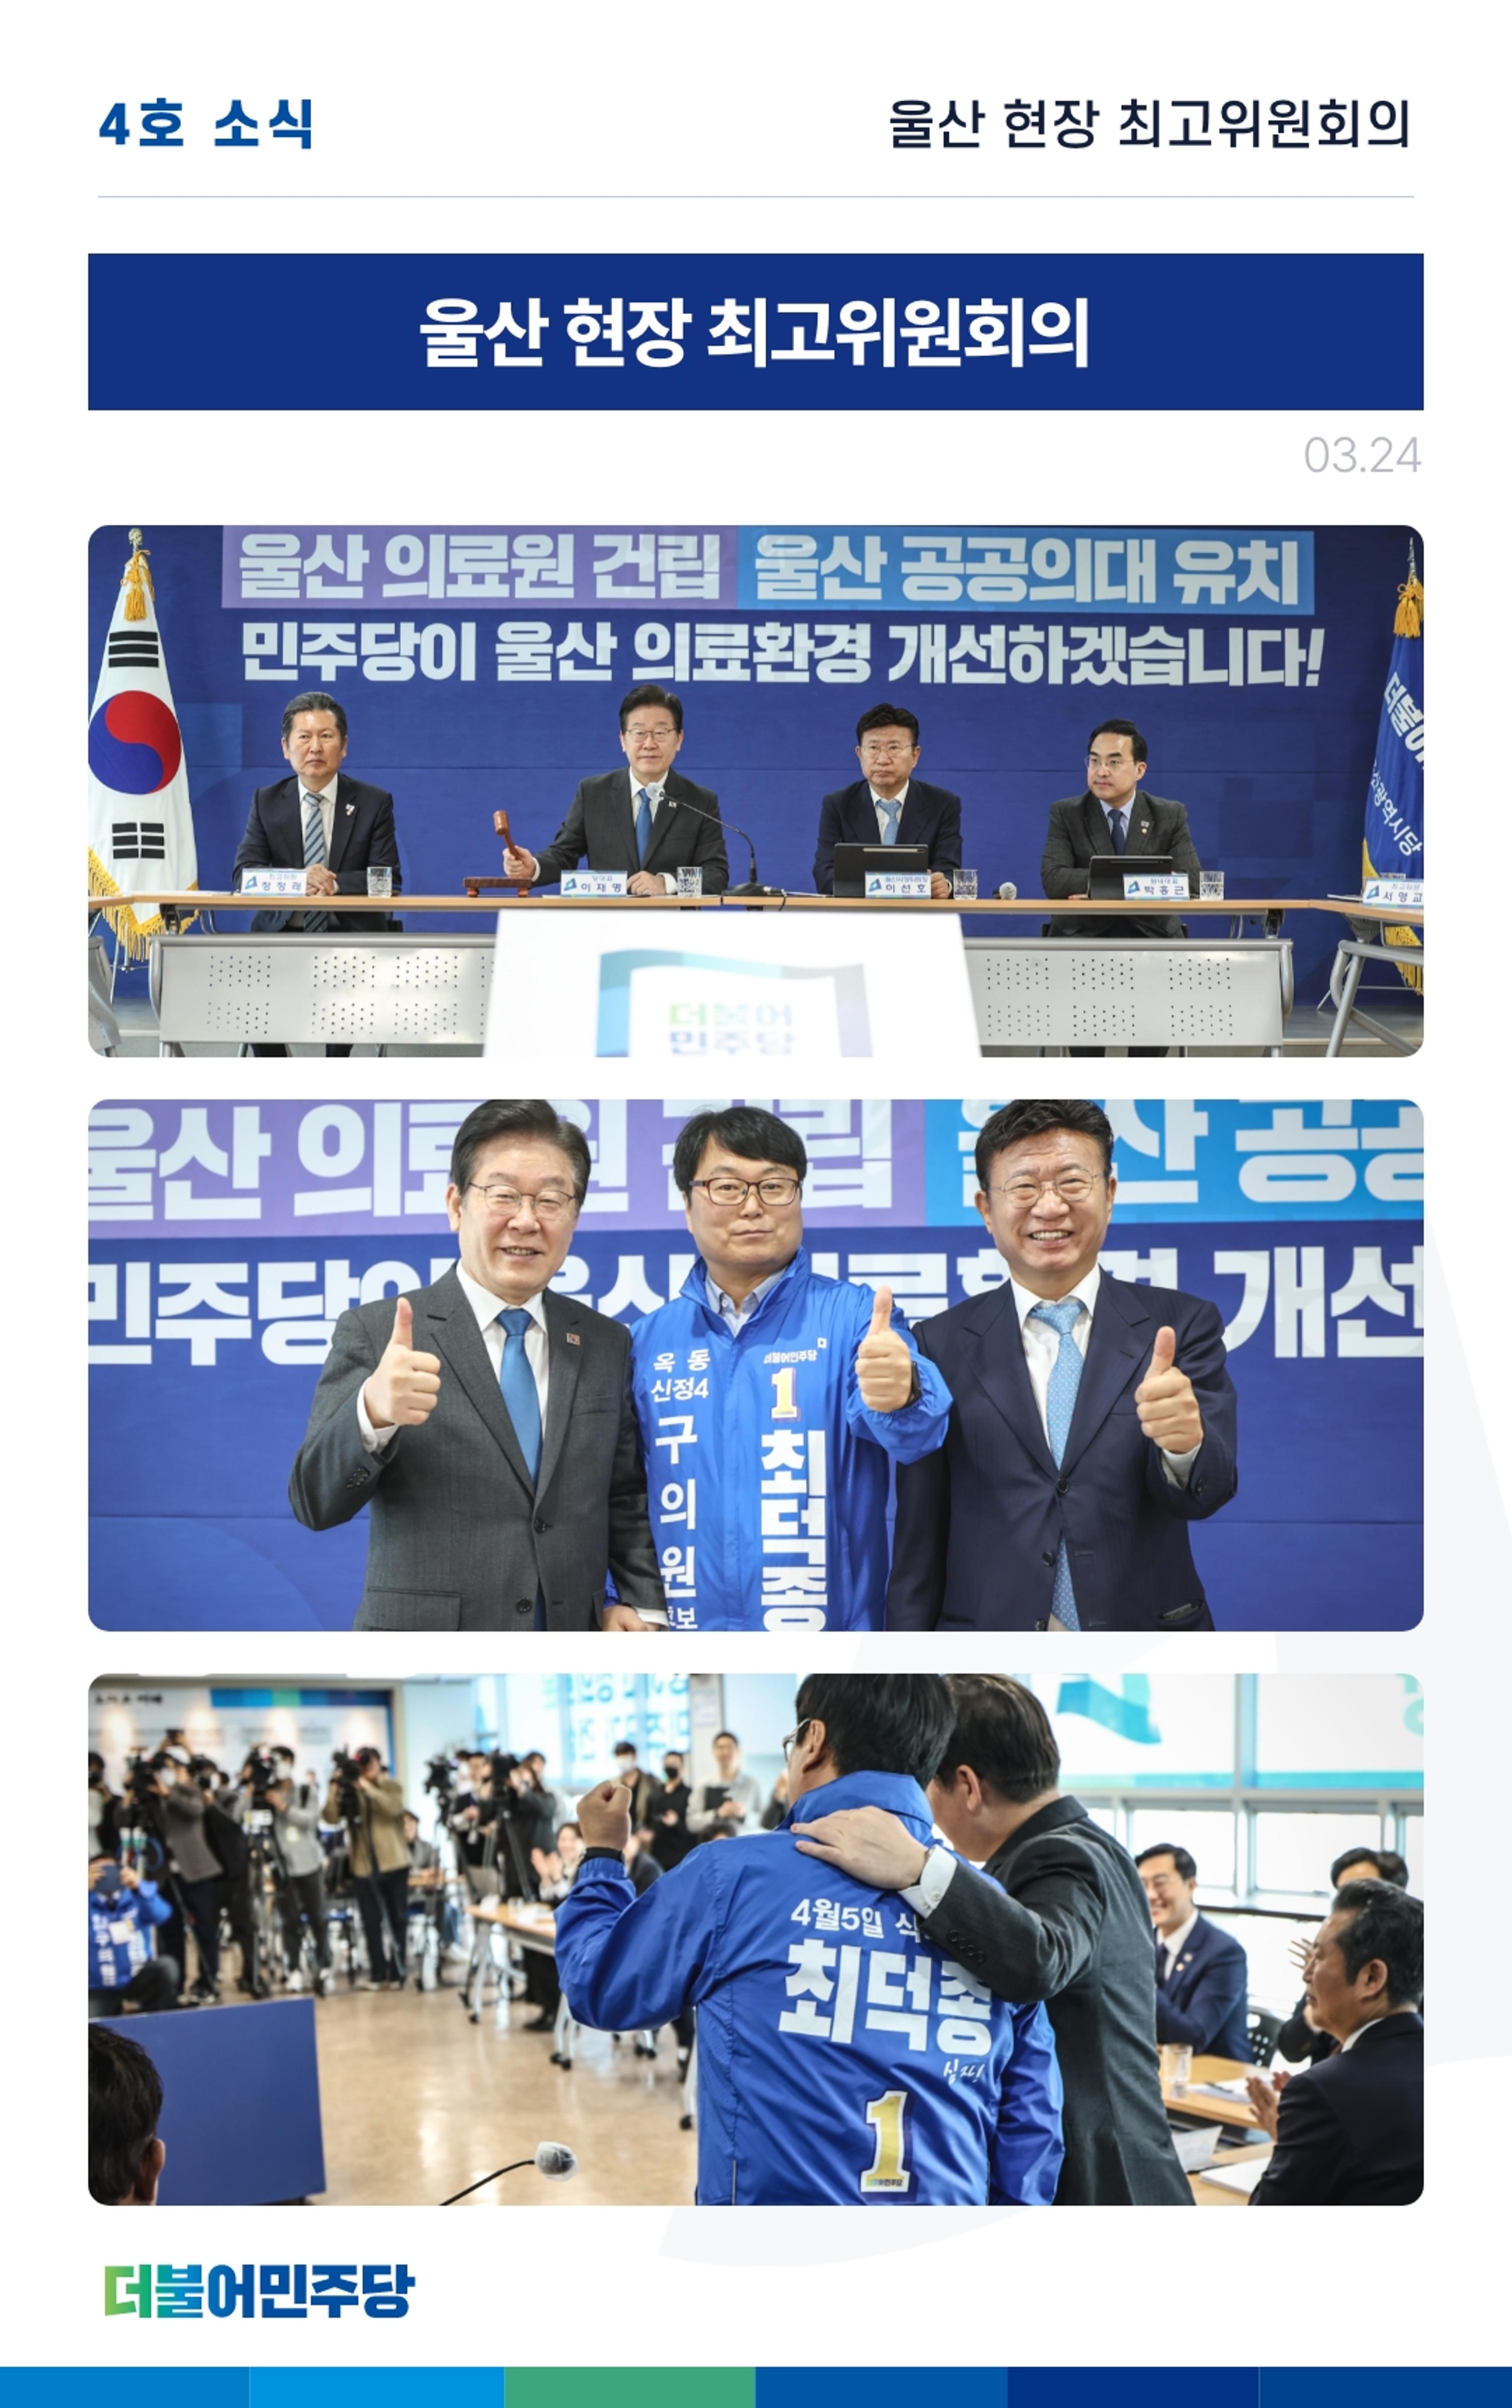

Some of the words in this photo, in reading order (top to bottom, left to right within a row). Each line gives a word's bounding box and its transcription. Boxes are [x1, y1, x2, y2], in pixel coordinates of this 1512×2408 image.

[239, 534, 370, 599] 울산
[383, 534, 575, 598] 의료원
[593, 534, 720, 599] 건립
[755, 535, 888, 600] 울산
[901, 536, 1156, 603] 공공의대
[1173, 539, 1299, 605] 유치
[242, 622, 476, 682] 민주당이
[495, 622, 617, 682] 울산
[633, 622, 872, 684] 의료환경
[889, 624, 1326, 687] 개선하겠습니다!
[1370, 758, 1423, 856] 산광역시당
[88, 1107, 271, 1221] 울산
[1214, 1246, 1424, 1358] 개선
[651, 1377, 709, 1402] 신정4
[771, 1367, 798, 1418] 1
[761, 1429, 828, 1631] 최덕종
[790, 1898, 884, 1939] 4월5일
[778, 1938, 992, 2057] 최덕종
[860, 2091, 910, 2193] 1
